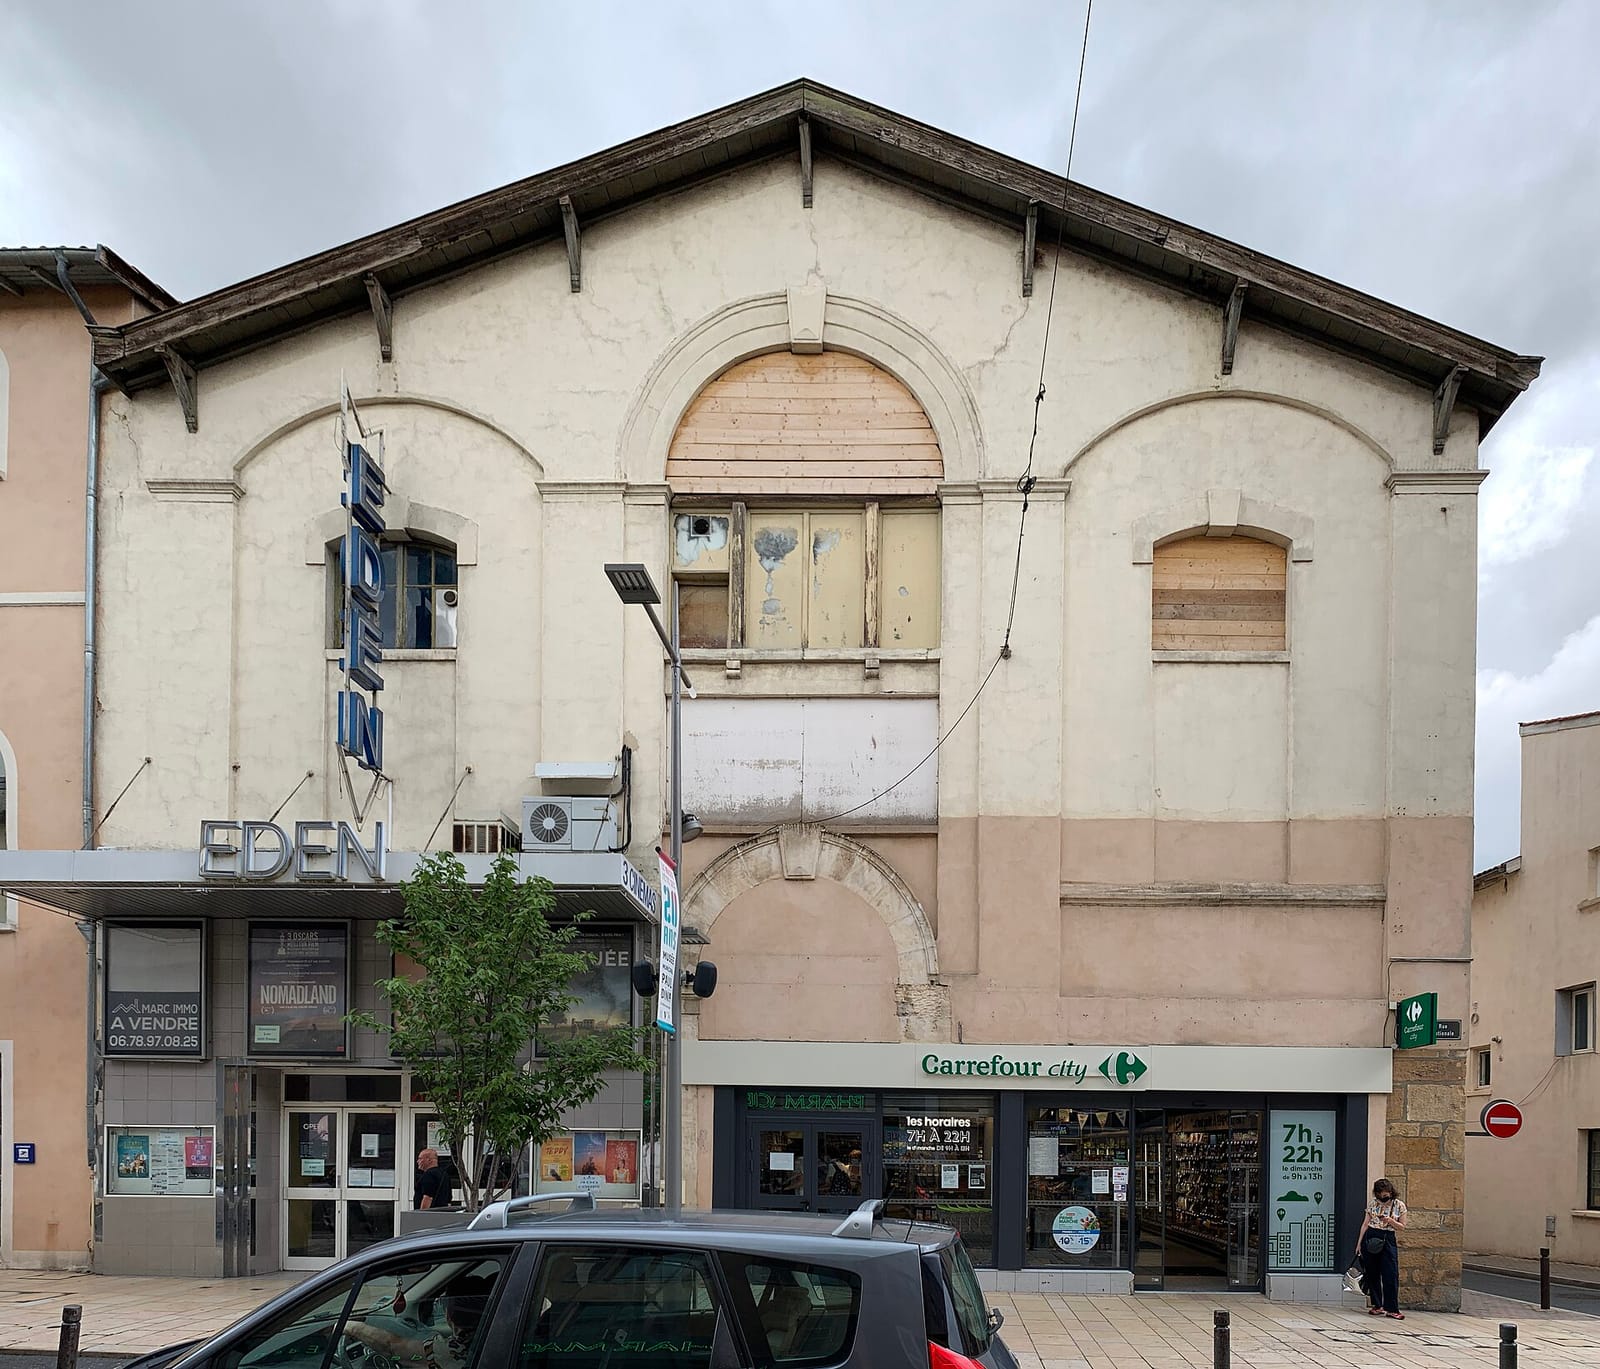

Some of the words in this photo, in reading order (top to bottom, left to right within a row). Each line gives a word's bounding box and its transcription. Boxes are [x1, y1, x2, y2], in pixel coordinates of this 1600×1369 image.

[343, 442, 386, 771] EDEN
[199, 820, 386, 882] EDEN
[622, 860, 629, 886] 3
[629, 868, 657, 914] CINEMAS
[293, 932, 319, 941] OSCARS
[260, 984, 337, 1005] NOMADLAND
[141, 1004, 170, 1014] MARC
[172, 1004, 198, 1014] IMMO
[110, 1016, 125, 1030] A
[128, 1016, 198, 1030] VENDRE
[109, 1035, 199, 1047] 06.78.97.08.25
[922, 1054, 1042, 1077] Carrefour
[1047, 1059, 1088, 1085] city
[906, 1116, 922, 1127] les
[924, 1116, 971, 1127] horaires
[906, 1129, 926, 1143] 7H
[929, 1127, 940, 1143] À
[943, 1130, 971, 1143] 22H
[1282, 1123, 1312, 1143] 7h
[1315, 1131, 1323, 1144] à
[545, 1146, 569, 1156] TEDDY
[1282, 1145, 1323, 1163] 22h
